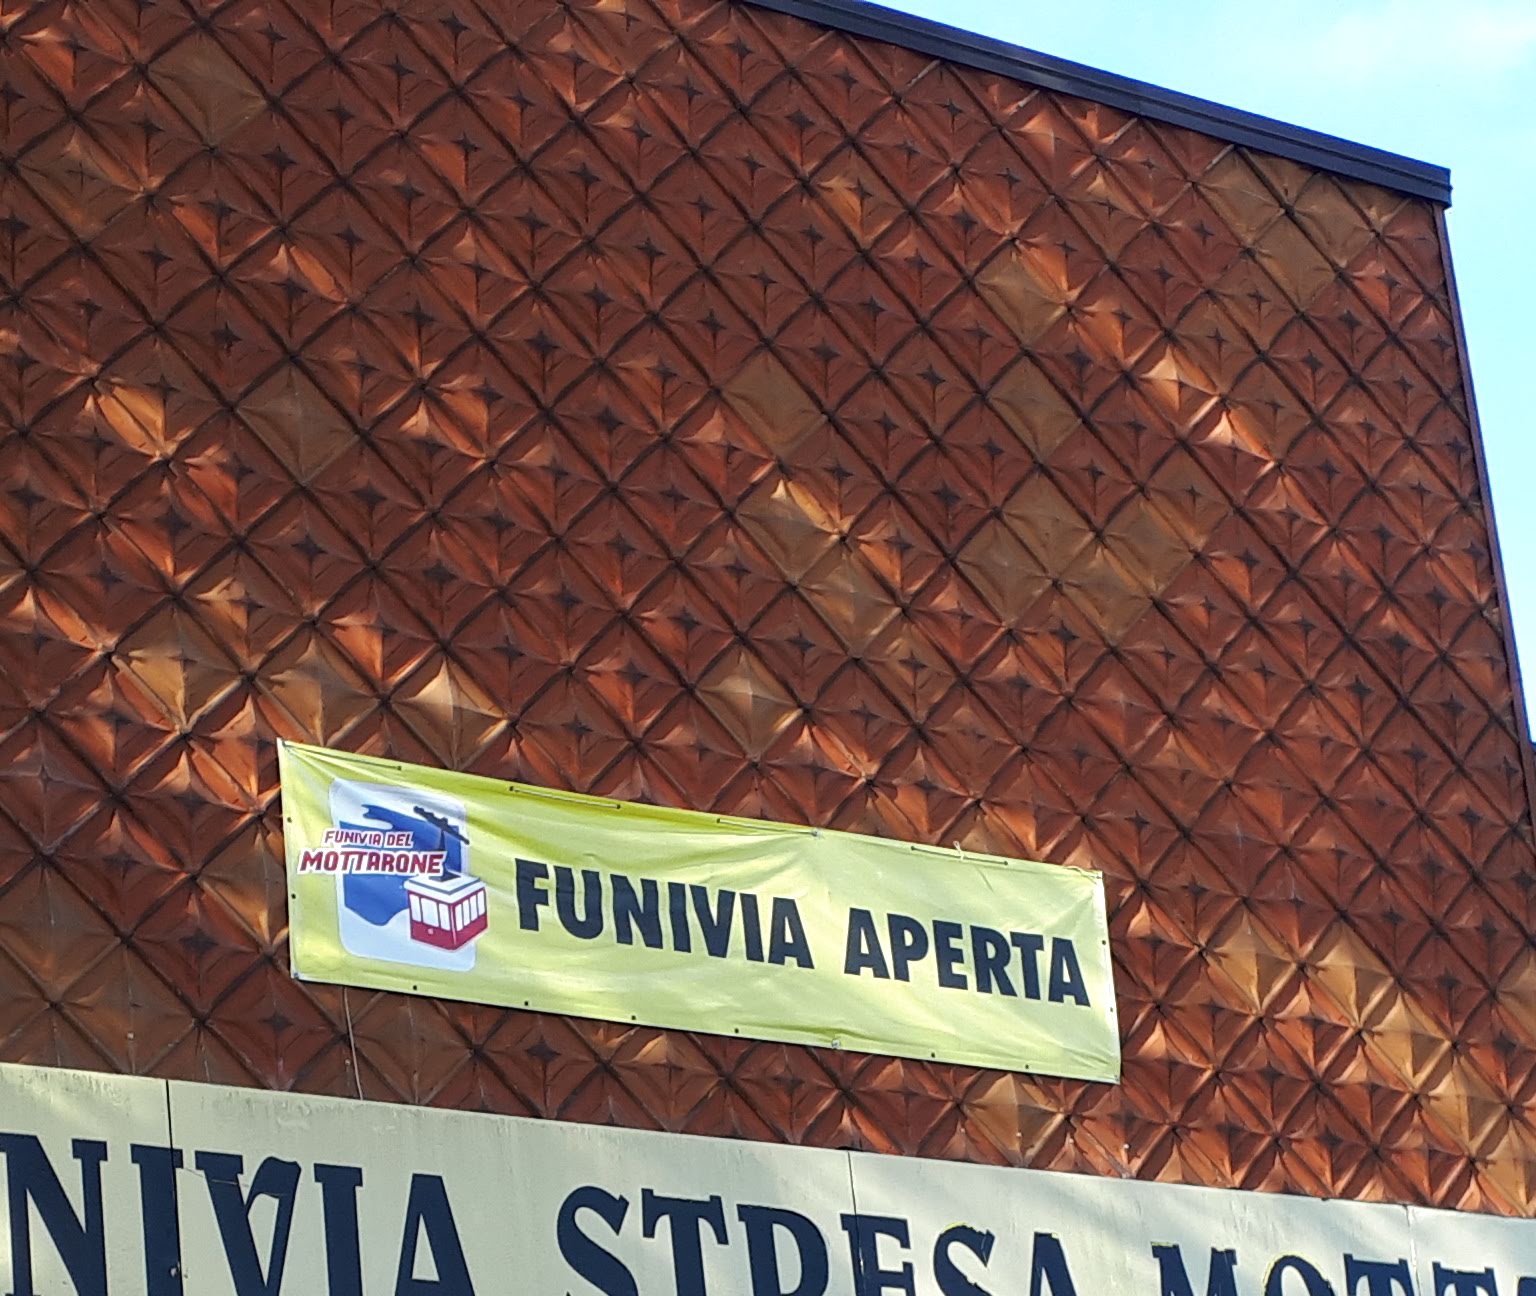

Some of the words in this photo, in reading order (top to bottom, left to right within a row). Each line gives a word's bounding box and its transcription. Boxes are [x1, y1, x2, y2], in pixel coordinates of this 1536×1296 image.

[324, 830, 381, 846] FUNIVIA
[386, 833, 414, 847] DEL
[300, 850, 445, 874] MOTTARONE
[515, 857, 814, 970] FUNIVIA
[843, 907, 1091, 1007] APERTA
